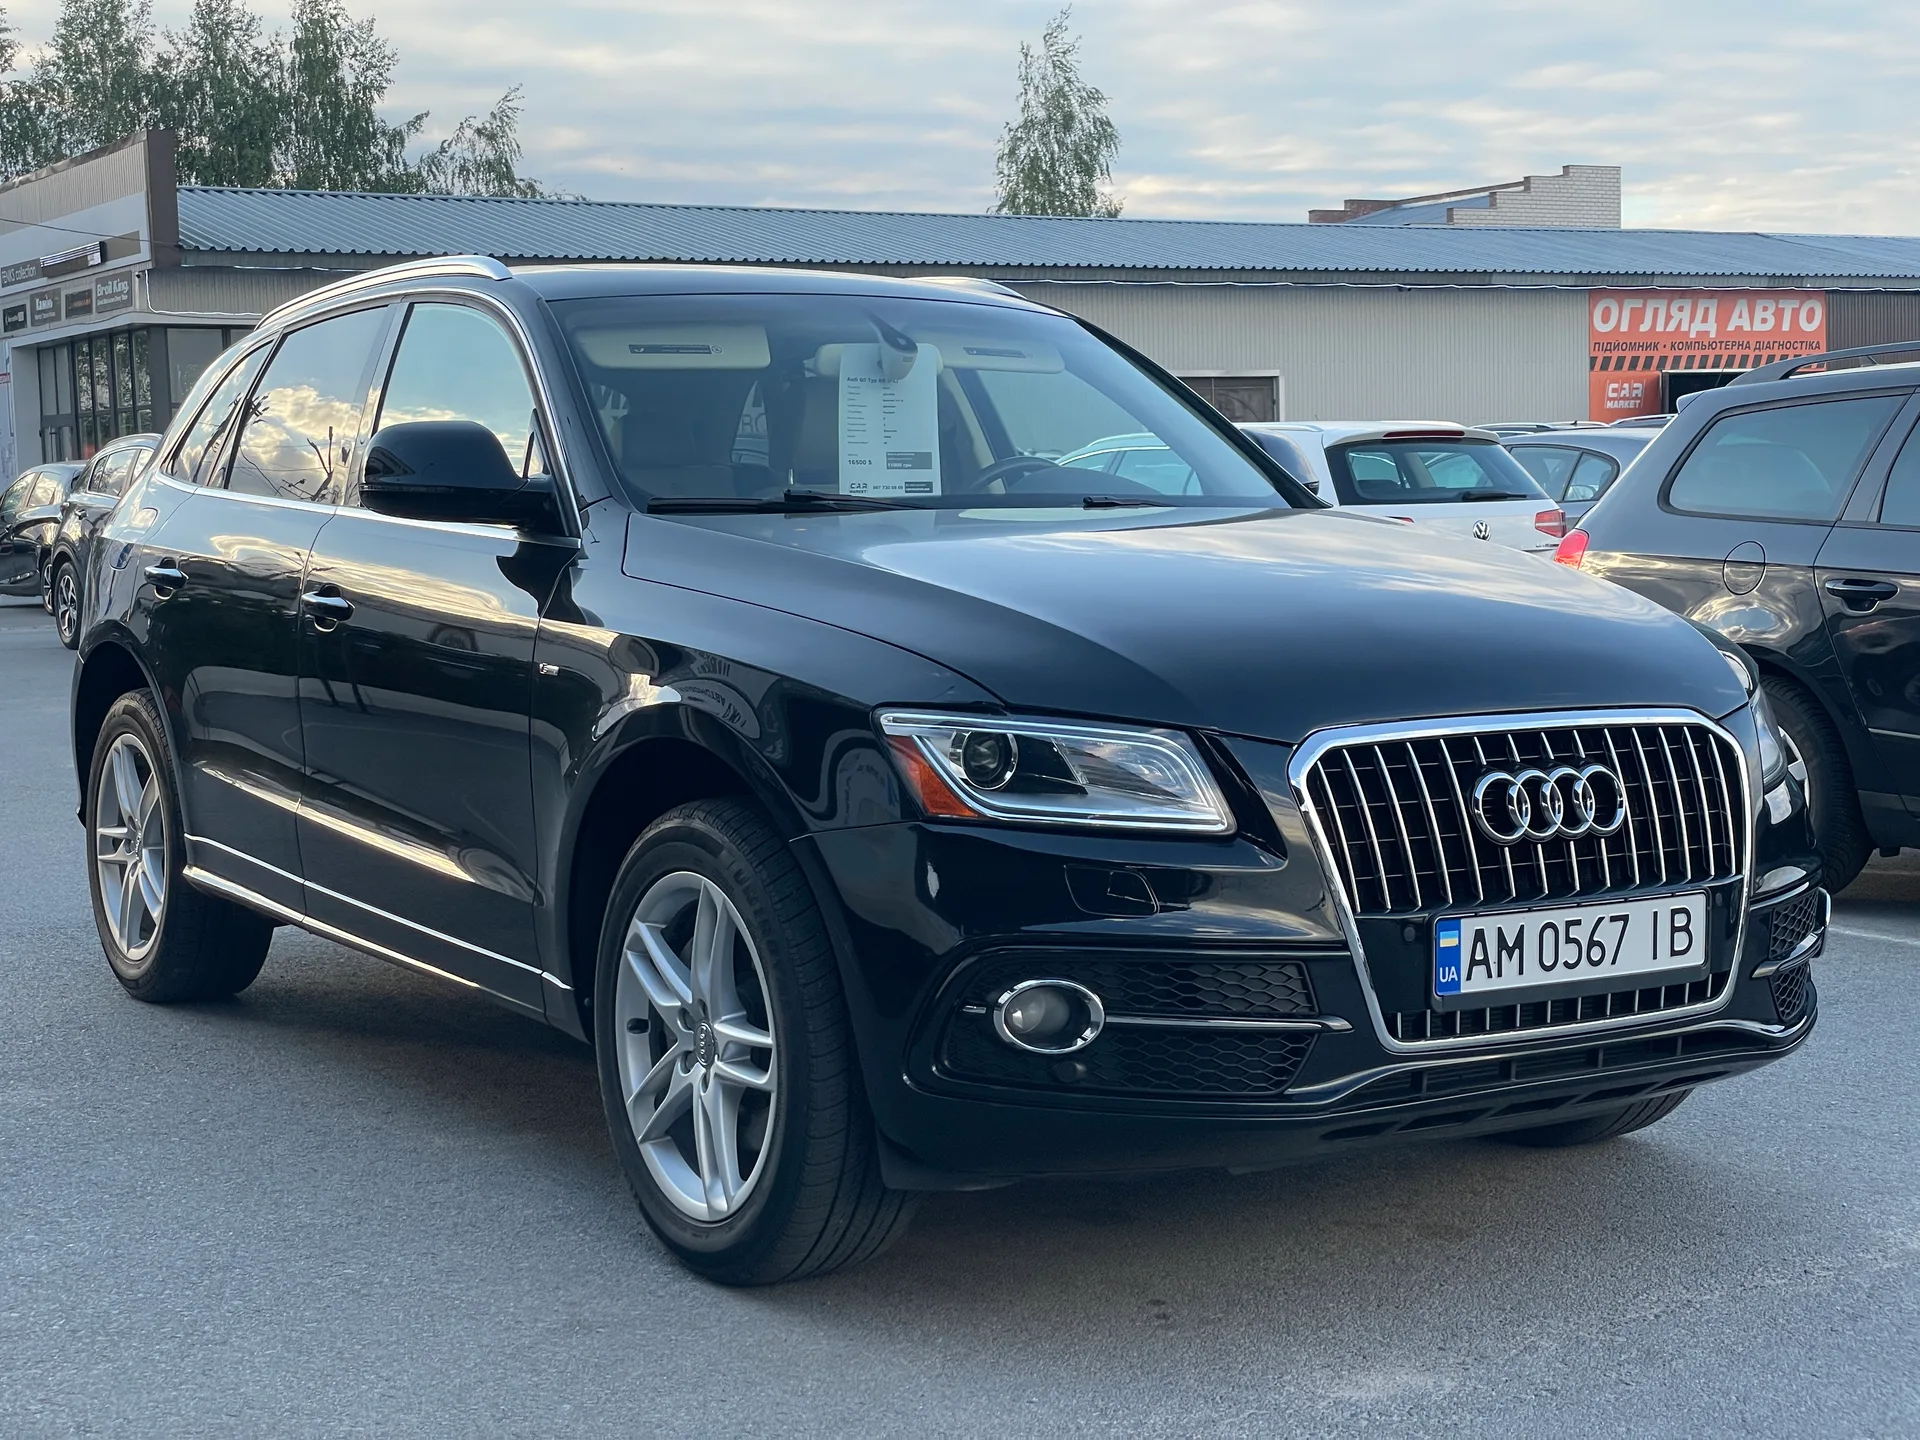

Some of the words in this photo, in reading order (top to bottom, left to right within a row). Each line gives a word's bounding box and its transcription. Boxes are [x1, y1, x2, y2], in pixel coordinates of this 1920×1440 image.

[113, 278, 129, 294] King
[1593, 298, 1718, 338] ОГЛЯД
[1726, 299, 1823, 332] АВТО
[1593, 340, 1660, 353] ПІДЙОМНИК
[1670, 340, 1751, 351] КОМПЬЮТЕРНА
[1754, 340, 1821, 352] ДІАГНОСТІКА
[1607, 382, 1644, 398] CAR
[1606, 400, 1640, 409] MARKET
[1466, 923, 1525, 982] AM
[1538, 914, 1630, 973] 0567
[1652, 906, 1694, 960] IB
[1439, 965, 1458, 983] UA
